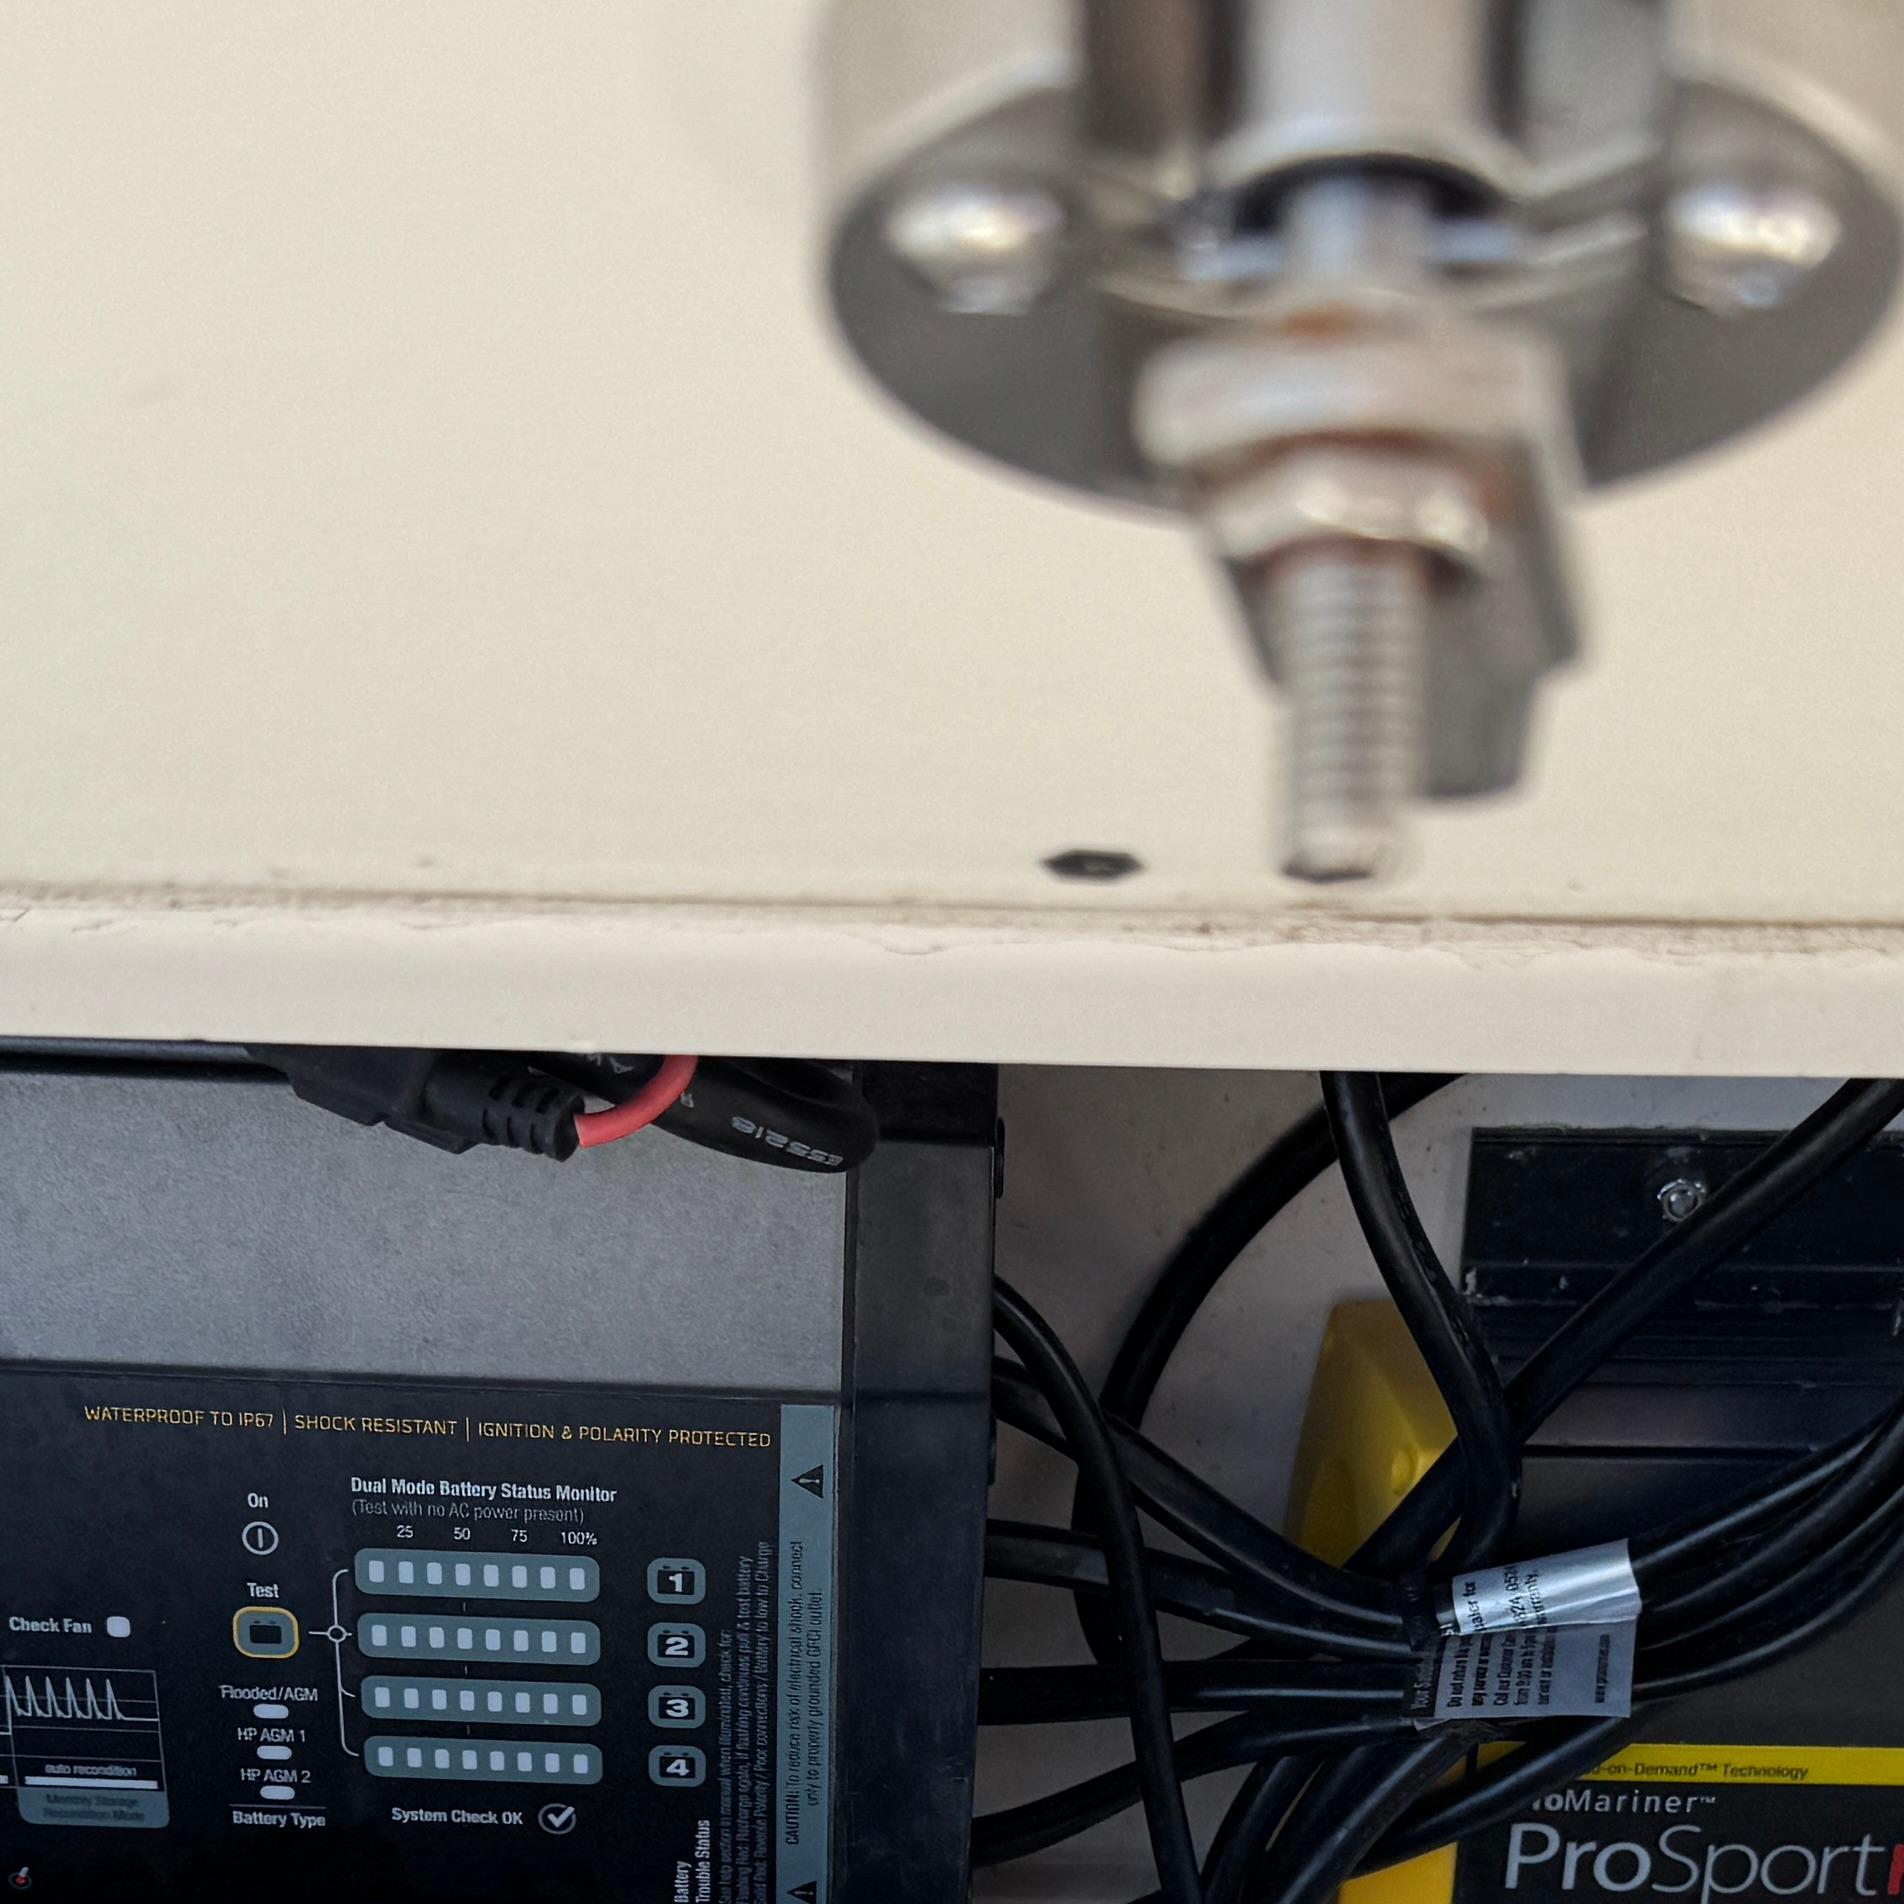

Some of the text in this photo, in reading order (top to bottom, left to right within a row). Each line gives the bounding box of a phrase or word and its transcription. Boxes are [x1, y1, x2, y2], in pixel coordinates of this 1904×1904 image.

[85, 1406, 772, 1448] WATERPROOF TO IP67 SHOCK RESISTANT IGNITION & POLARITY PROTECTED
[351, 1477, 617, 1502] Dual Mode Battery Status Monitor
[247, 1492, 269, 1508] On
[351, 1498, 585, 1524] (Test with no AC power present)
[396, 1525, 598, 1546] 25 50 75 100%
[789, 1540, 804, 1590] connect
[246, 1582, 280, 1599] Test
[668, 1572, 683, 1592] 1
[8, 1616, 92, 1634] Check Fan
[664, 1636, 689, 1656] 2
[218, 1684, 318, 1701] Flooded/AGM
[786, 1694, 801, 1706] of
[665, 1698, 689, 1718] 3
[237, 1727, 306, 1742] HP AGM 1
[241, 1768, 312, 1784] HP AGM 2
[666, 1758, 690, 1777] 4
[1722, 1763, 1808, 1780] Technology
[232, 1810, 326, 1829] Battery Type
[391, 1807, 524, 1825] System Check OK
[785, 1790, 801, 1845] CAUTION:
[695, 1819, 711, 1904] Trouble Status
[674, 1860, 692, 1904] Battery
